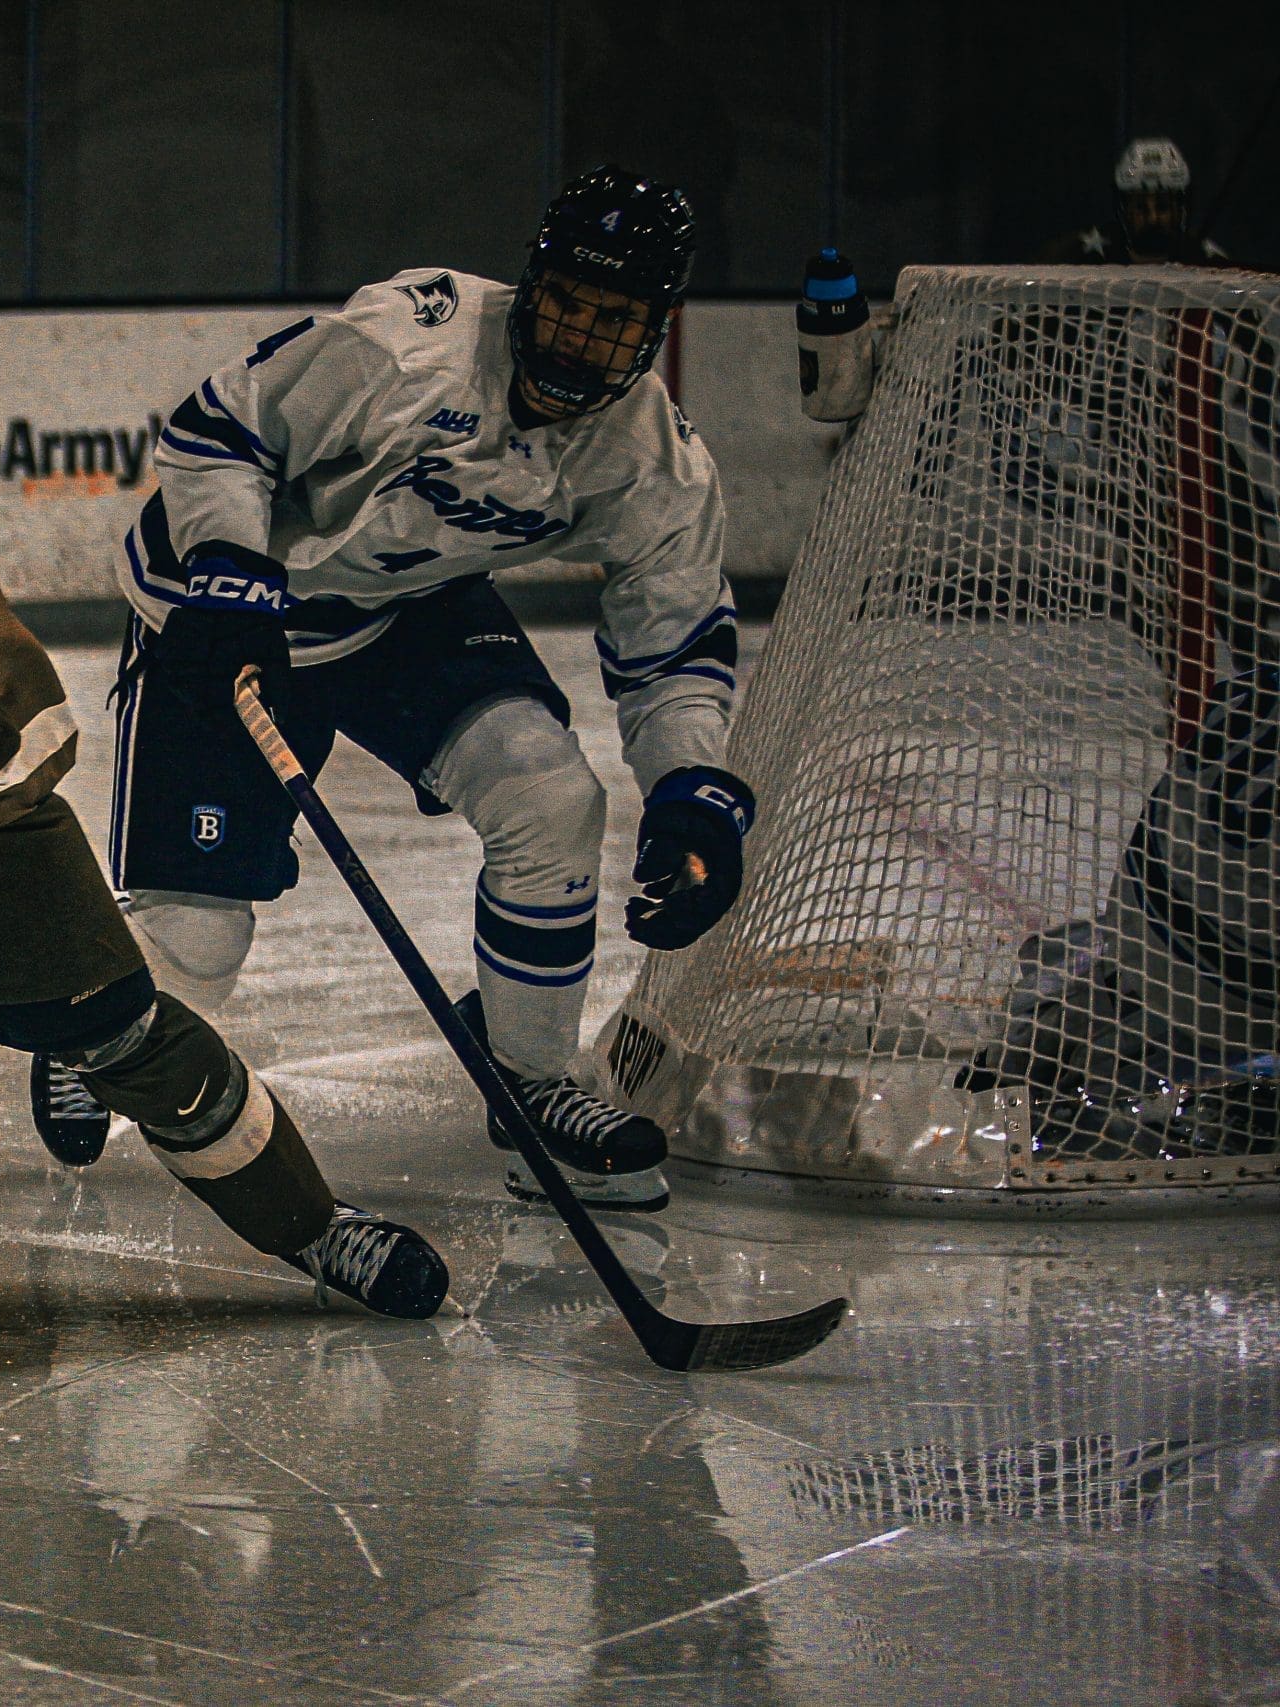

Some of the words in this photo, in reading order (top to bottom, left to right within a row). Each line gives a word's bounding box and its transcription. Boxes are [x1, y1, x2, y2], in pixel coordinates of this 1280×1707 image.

[601, 210, 621, 232] 4
[573, 246, 624, 270] CCM
[187, 575, 283, 611] CCM
[464, 633, 519, 647] CCM
[197, 814, 220, 841] B
